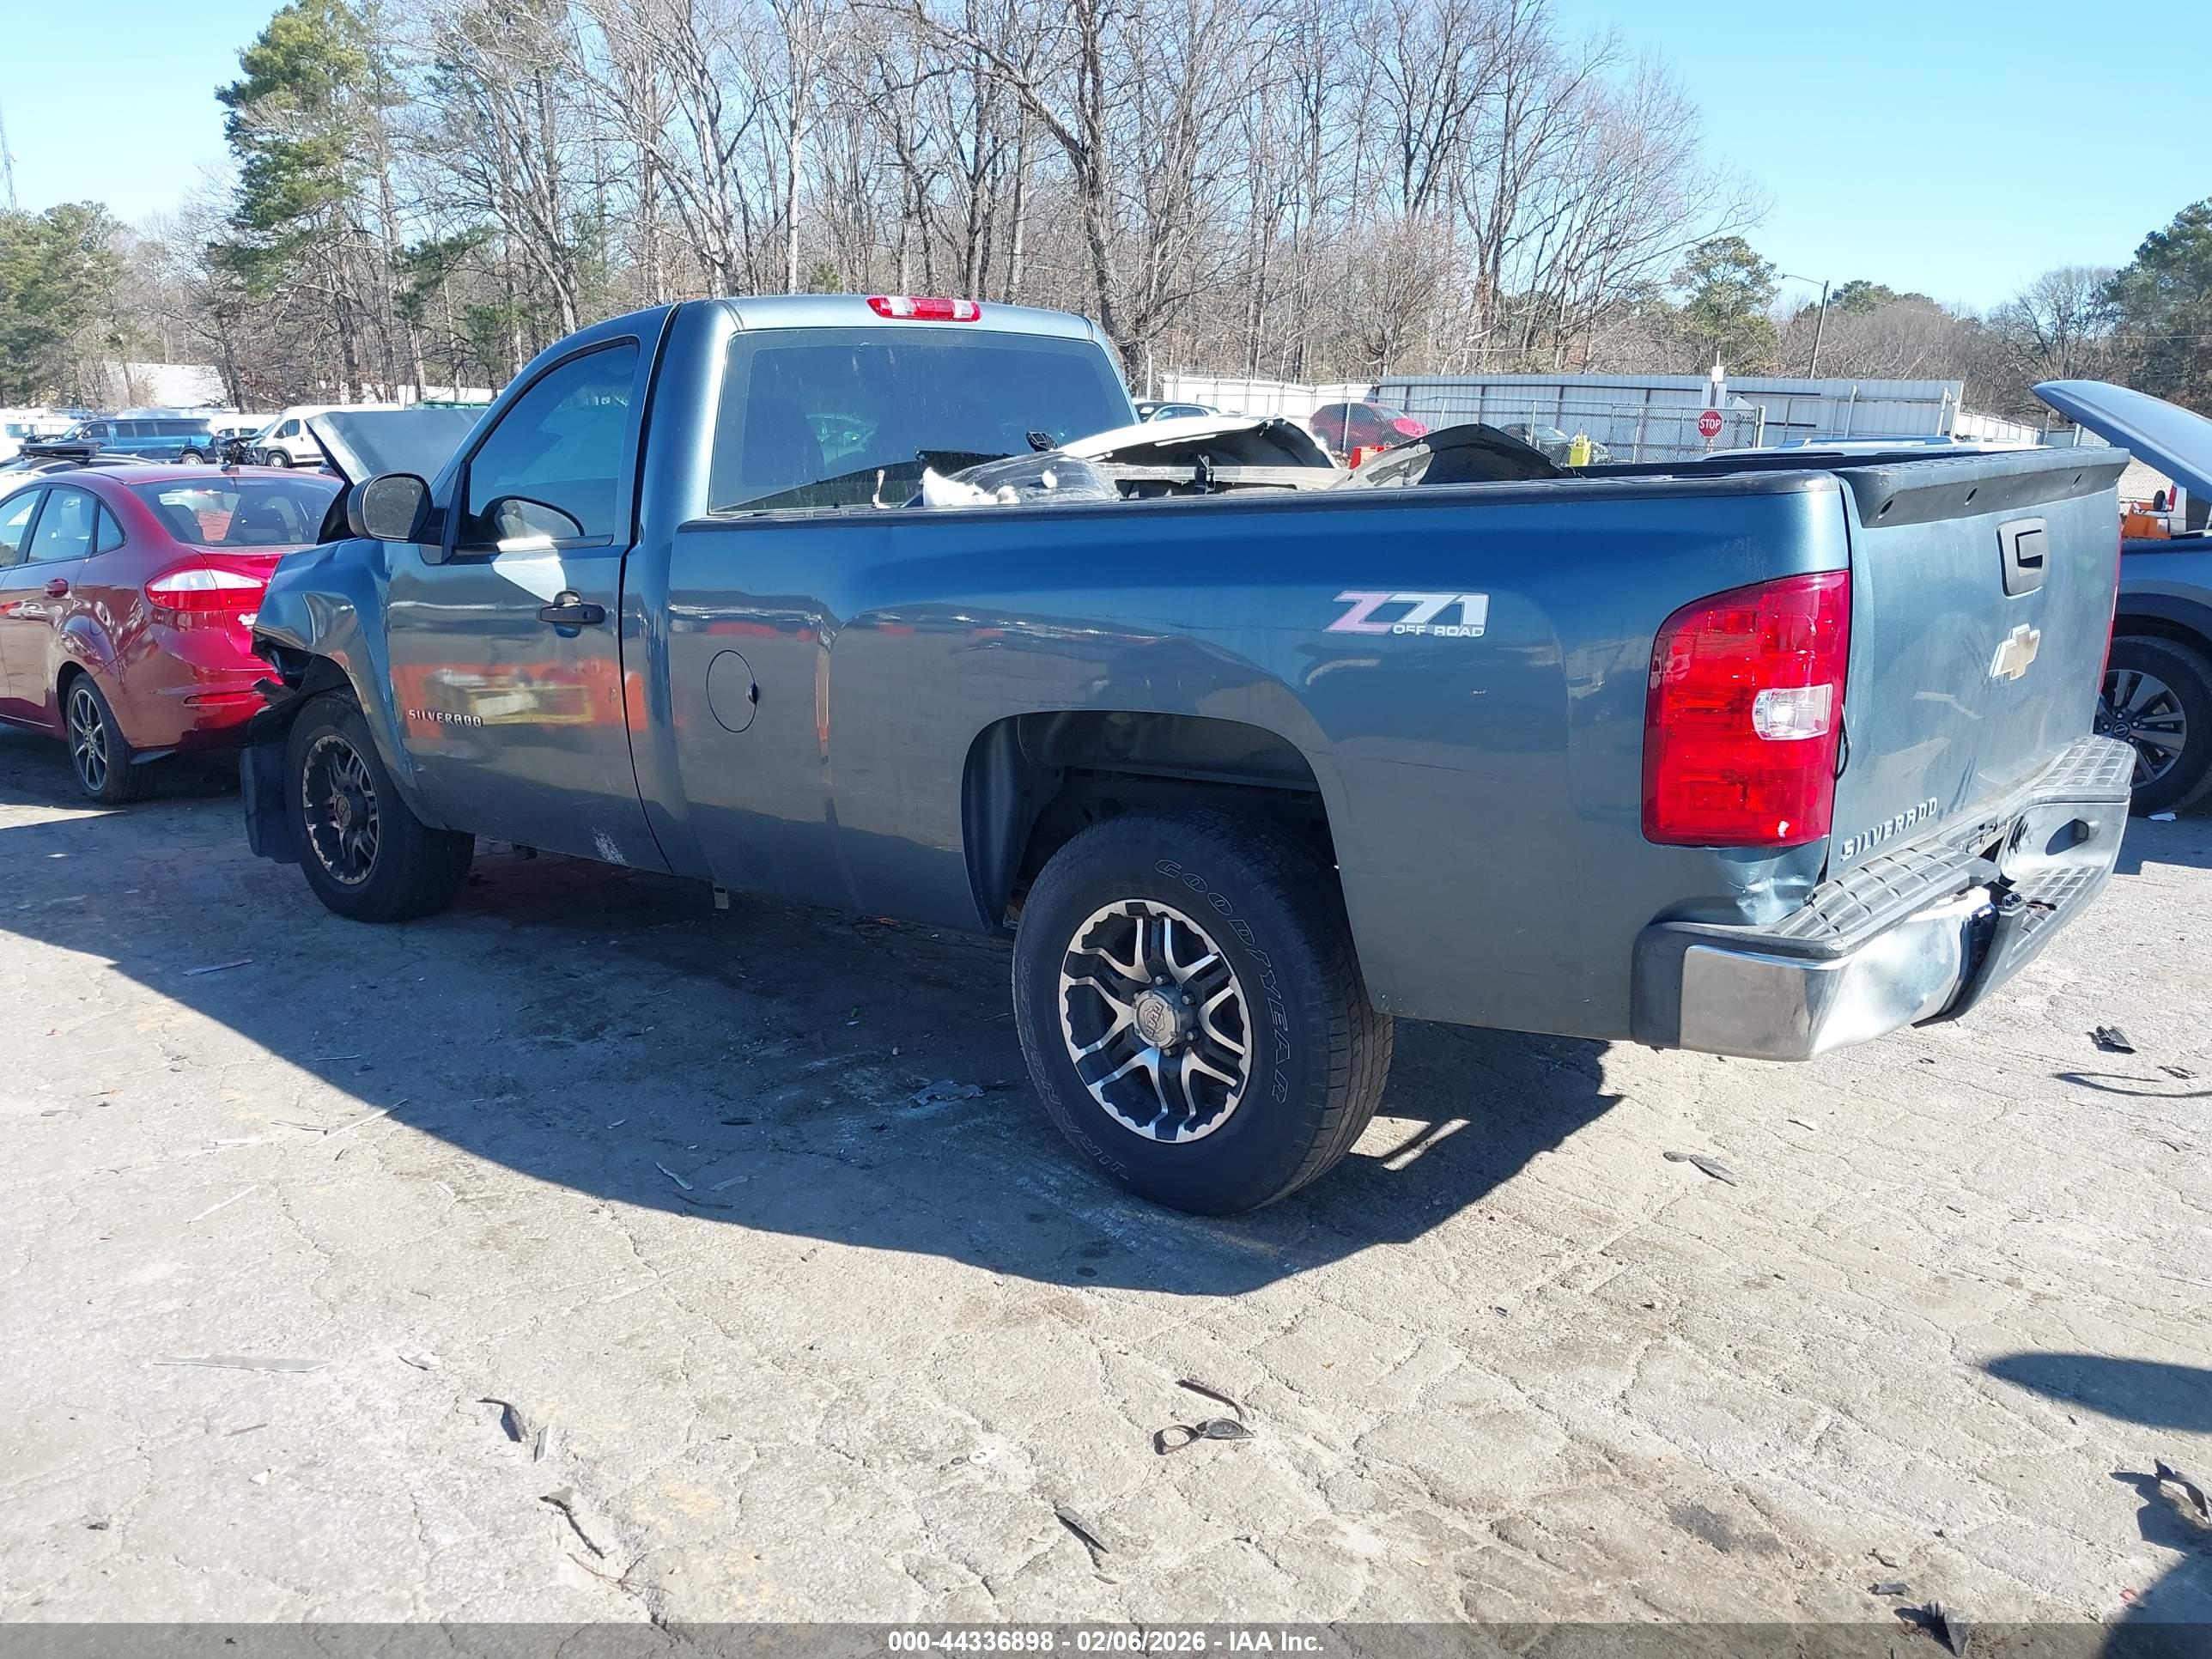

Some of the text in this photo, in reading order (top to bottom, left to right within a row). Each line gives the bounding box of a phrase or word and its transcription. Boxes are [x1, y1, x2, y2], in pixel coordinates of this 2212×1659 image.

[1699, 418, 1722, 428] STOP
[1323, 592, 1489, 633] Z71
[1393, 624, 1485, 636] OFF ROAD
[408, 708, 483, 727] SILVERADO
[1840, 796, 1938, 862] SILVERADO
[1154, 859, 1291, 1105] GOODYEAR
